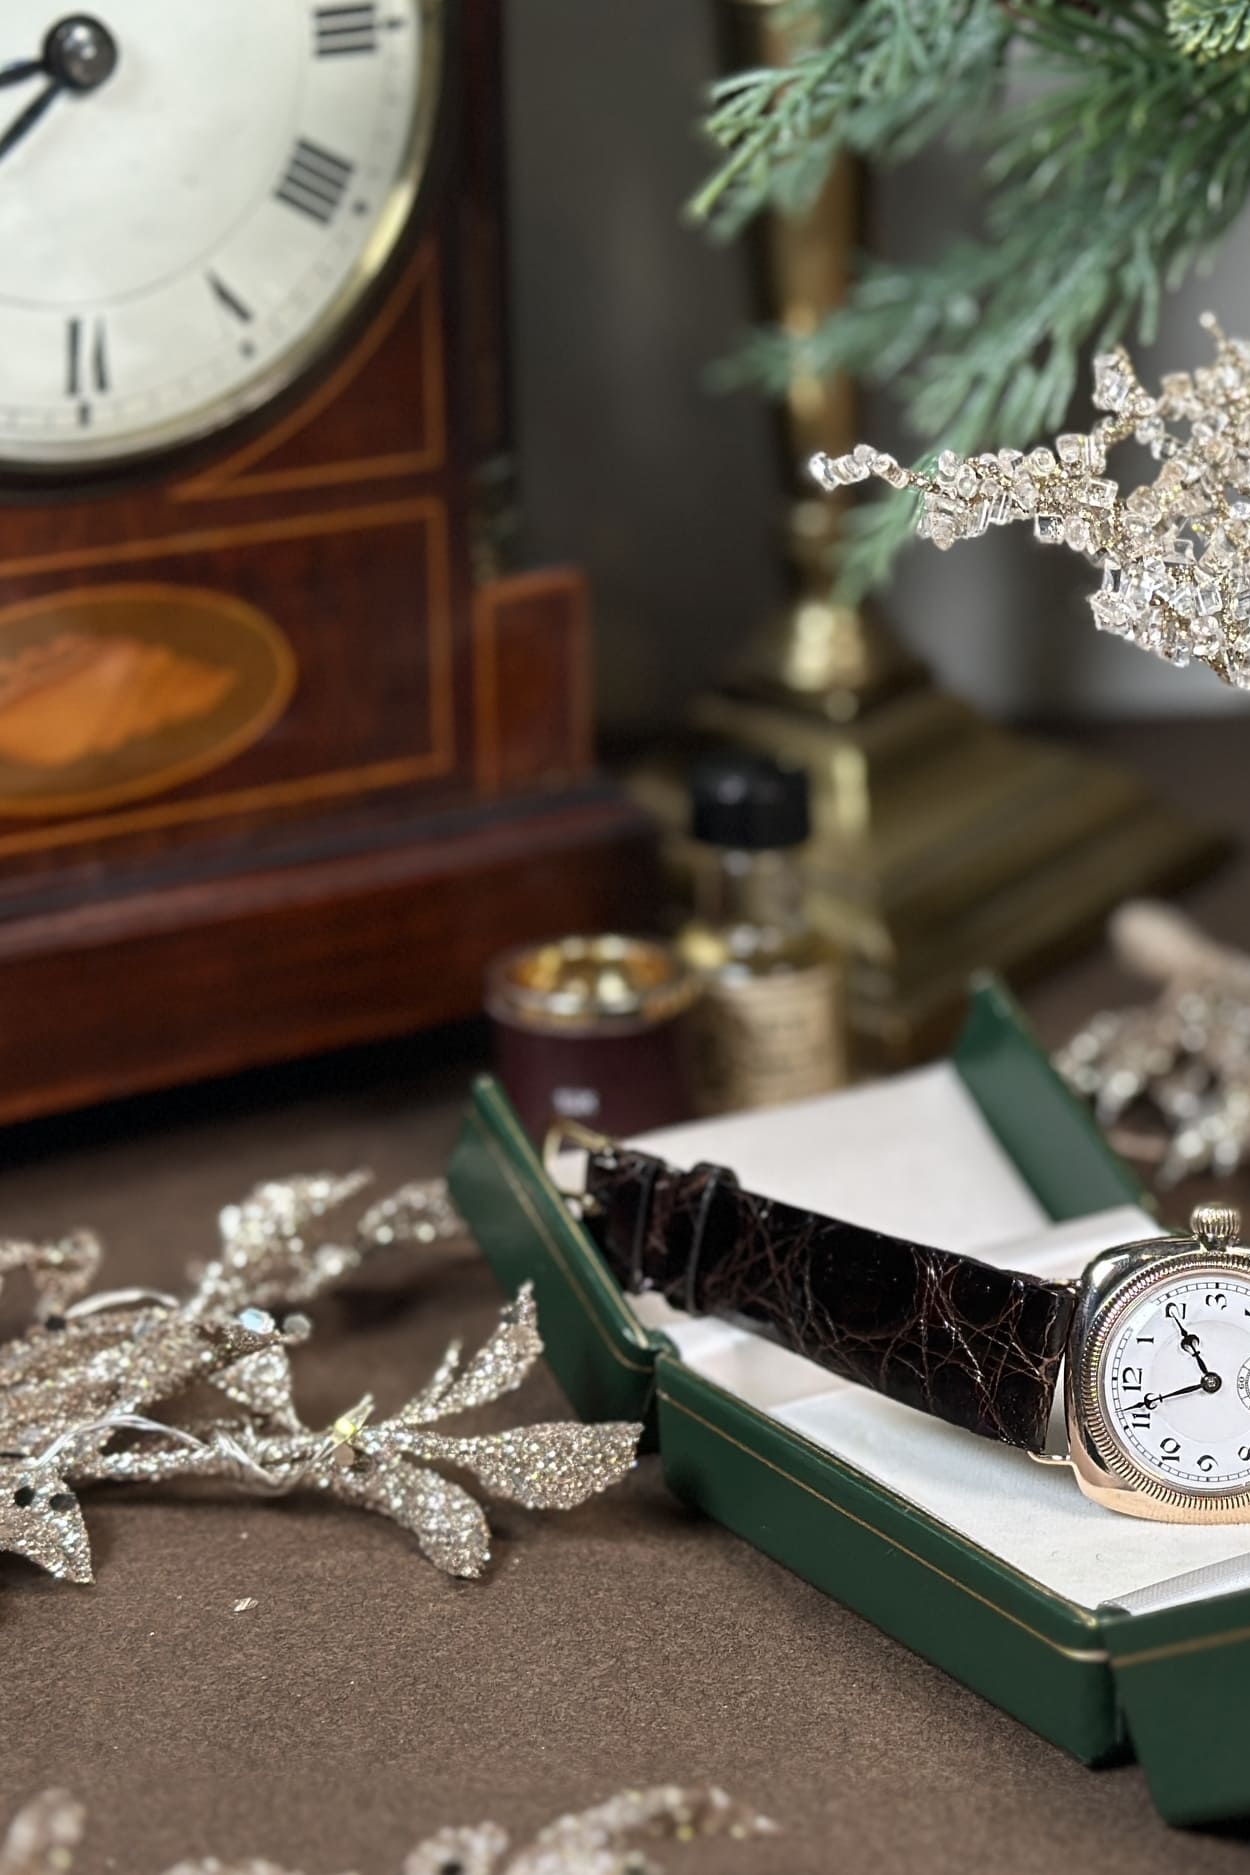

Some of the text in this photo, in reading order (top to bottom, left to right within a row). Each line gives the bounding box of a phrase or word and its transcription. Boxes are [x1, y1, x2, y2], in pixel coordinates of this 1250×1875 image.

[1205, 1293, 1227, 1310] 3
[1165, 1302, 1187, 1320] 2
[1122, 1367, 1143, 1391] 12
[1131, 1413, 1151, 1429] 11
[1160, 1437, 1181, 1462] 10
[1197, 1454, 1219, 1472] 9
